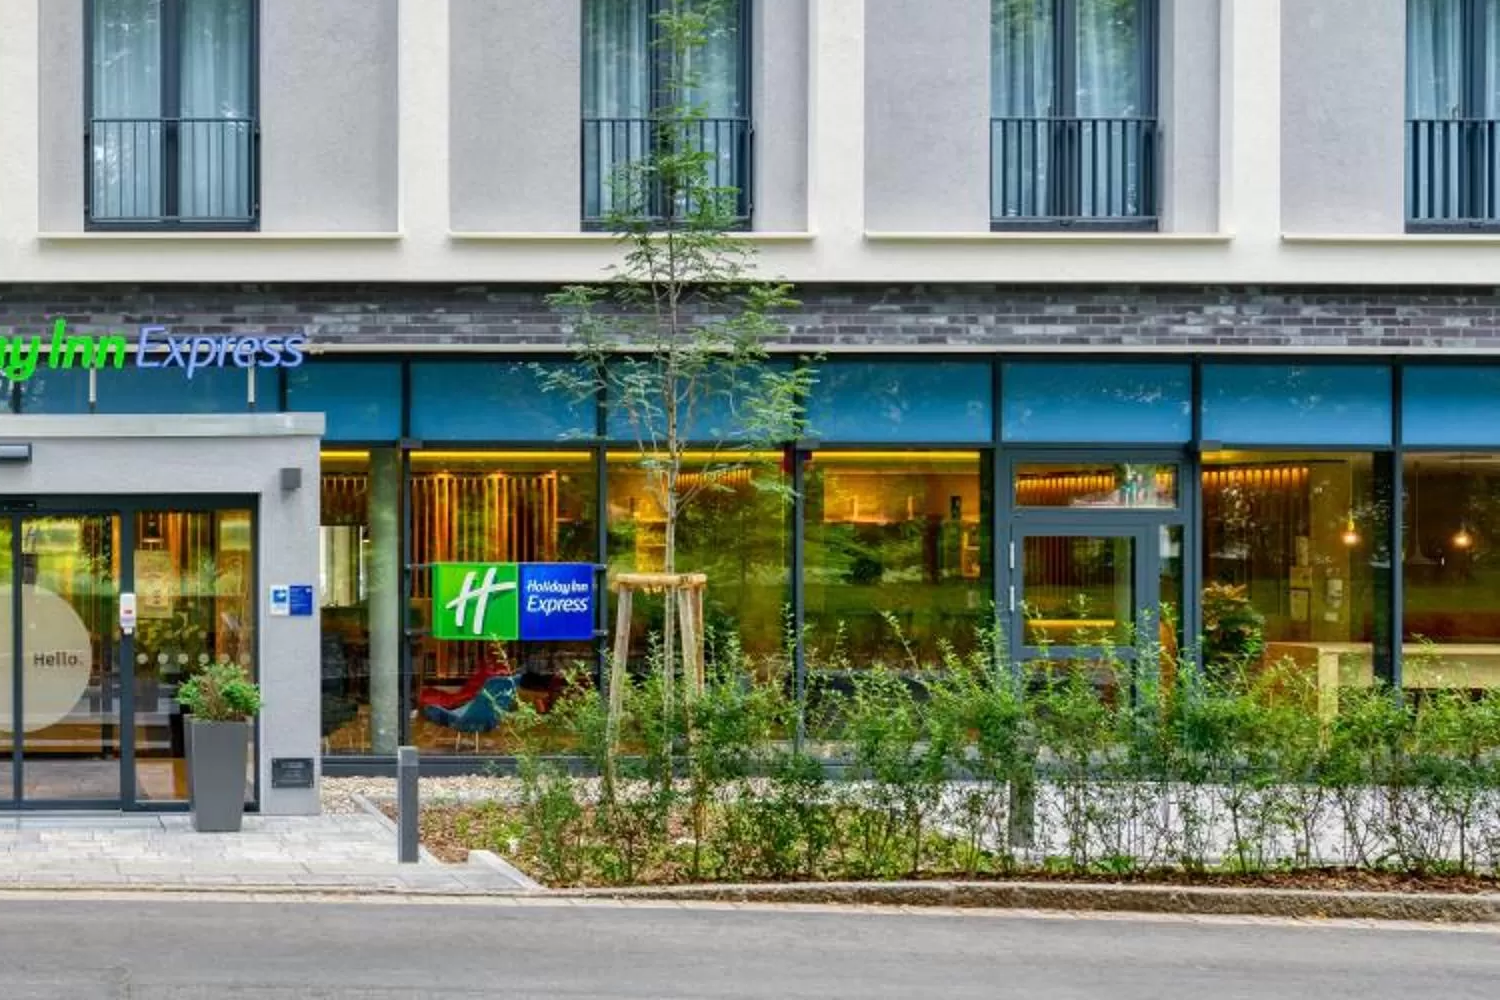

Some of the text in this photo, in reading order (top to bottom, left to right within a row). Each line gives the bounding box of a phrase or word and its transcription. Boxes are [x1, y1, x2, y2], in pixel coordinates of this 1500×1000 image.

[48, 317, 127, 369] Inn
[136, 324, 304, 380] Express
[526, 579, 589, 595] Holiday Inn
[526, 595, 589, 616] Express
[33, 651, 84, 666] Hello.
